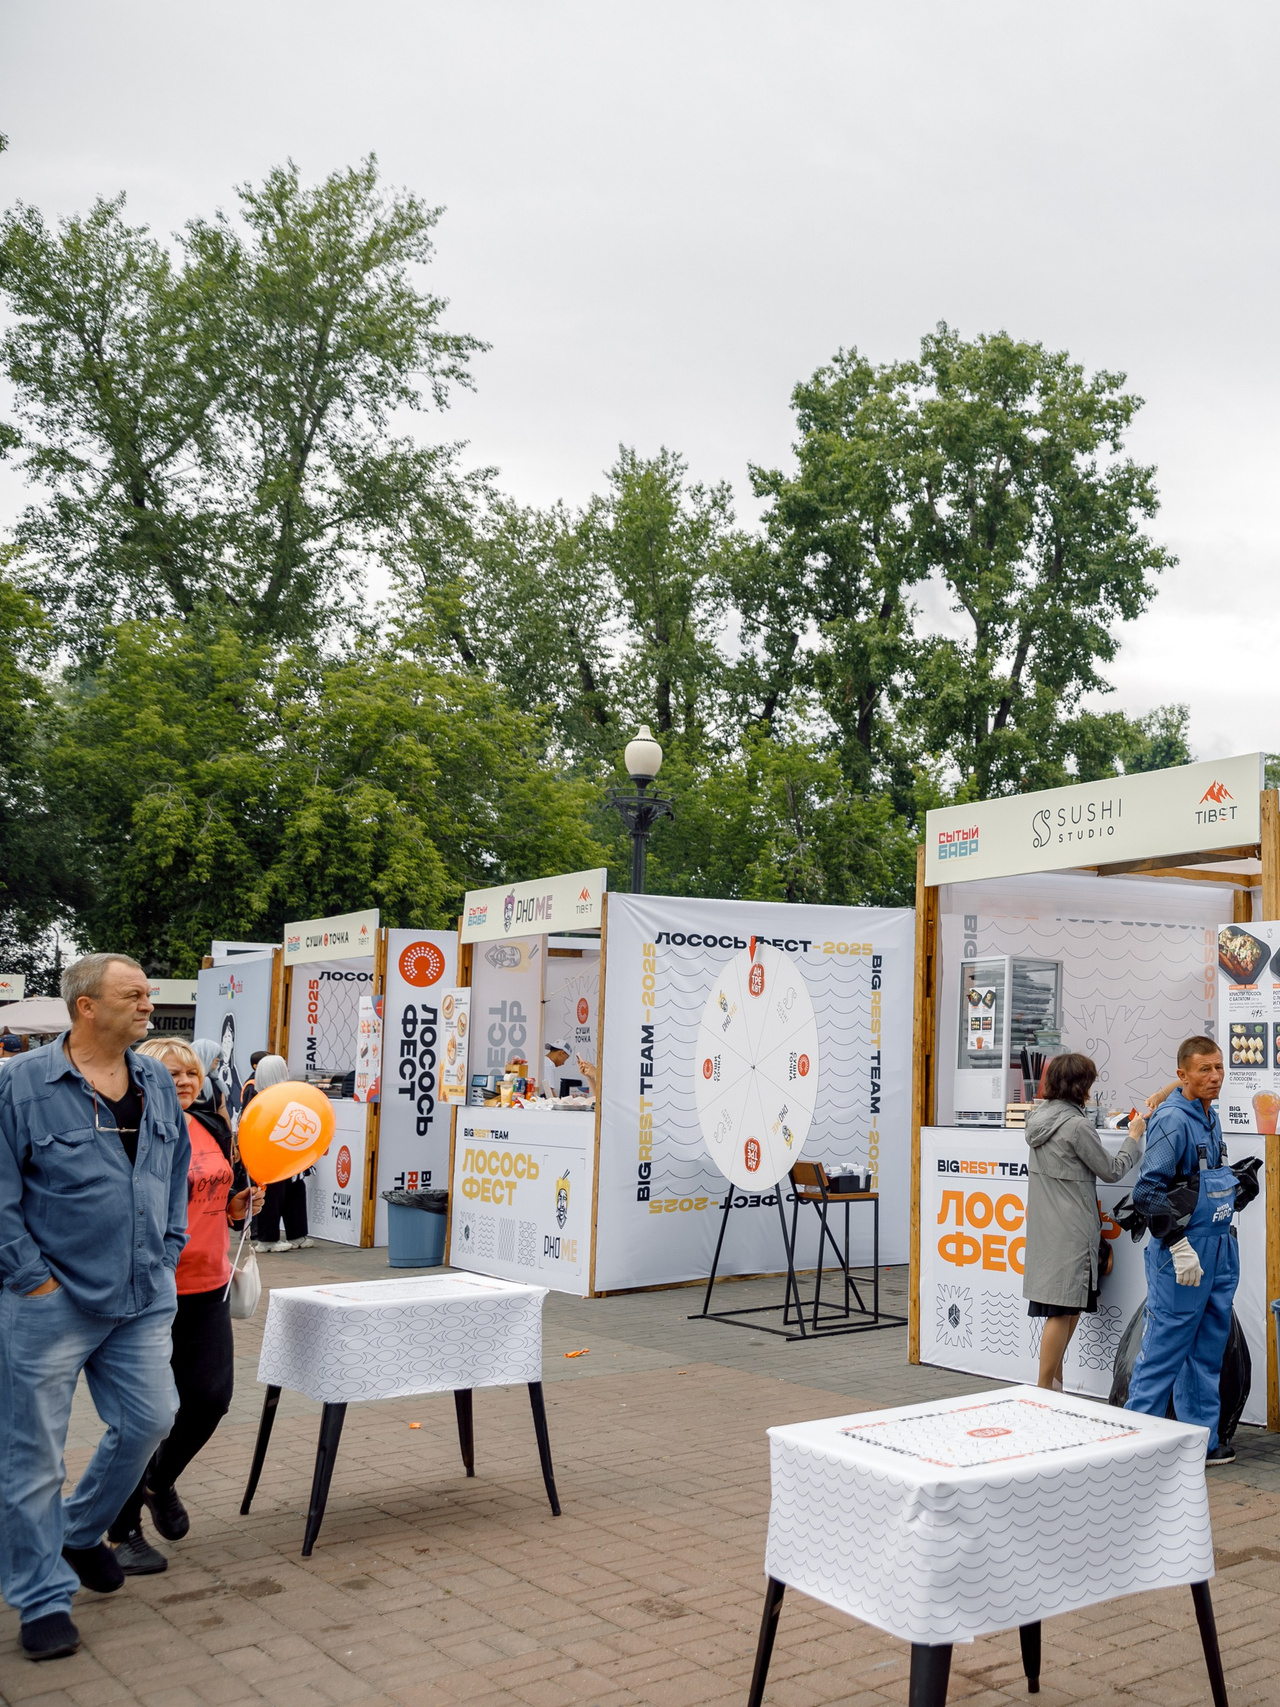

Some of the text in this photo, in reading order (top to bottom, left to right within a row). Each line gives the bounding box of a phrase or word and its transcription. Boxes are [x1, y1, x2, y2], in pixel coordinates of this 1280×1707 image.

[1057, 798, 1123, 827] SUSHI
[1195, 805, 1238, 825] TIBET
[939, 825, 979, 844] СЫТЫЙ
[1058, 825, 1115, 843] STUDIO
[938, 839, 979, 860] БАБР
[469, 904, 488, 916] СЫТЫЙ
[576, 903, 593, 914] TIBET
[468, 914, 487, 927] БАБР
[306, 931, 349, 948] СУШИ ТОЧКА
[655, 932, 747, 949] ЛОСОСЬ
[574, 1034, 591, 1043] ТОЧКА
[575, 1026, 591, 1035] СУШИ
[398, 1004, 418, 1101] ФЕСТ
[416, 1003, 438, 1137] ЛОСОСЬ
[462, 1148, 539, 1180] ЛОСОСЬ
[332, 1192, 351, 1207] СУШИ
[461, 1176, 517, 1206] ФЕСТ
[331, 1206, 352, 1221] ТОЧКА
